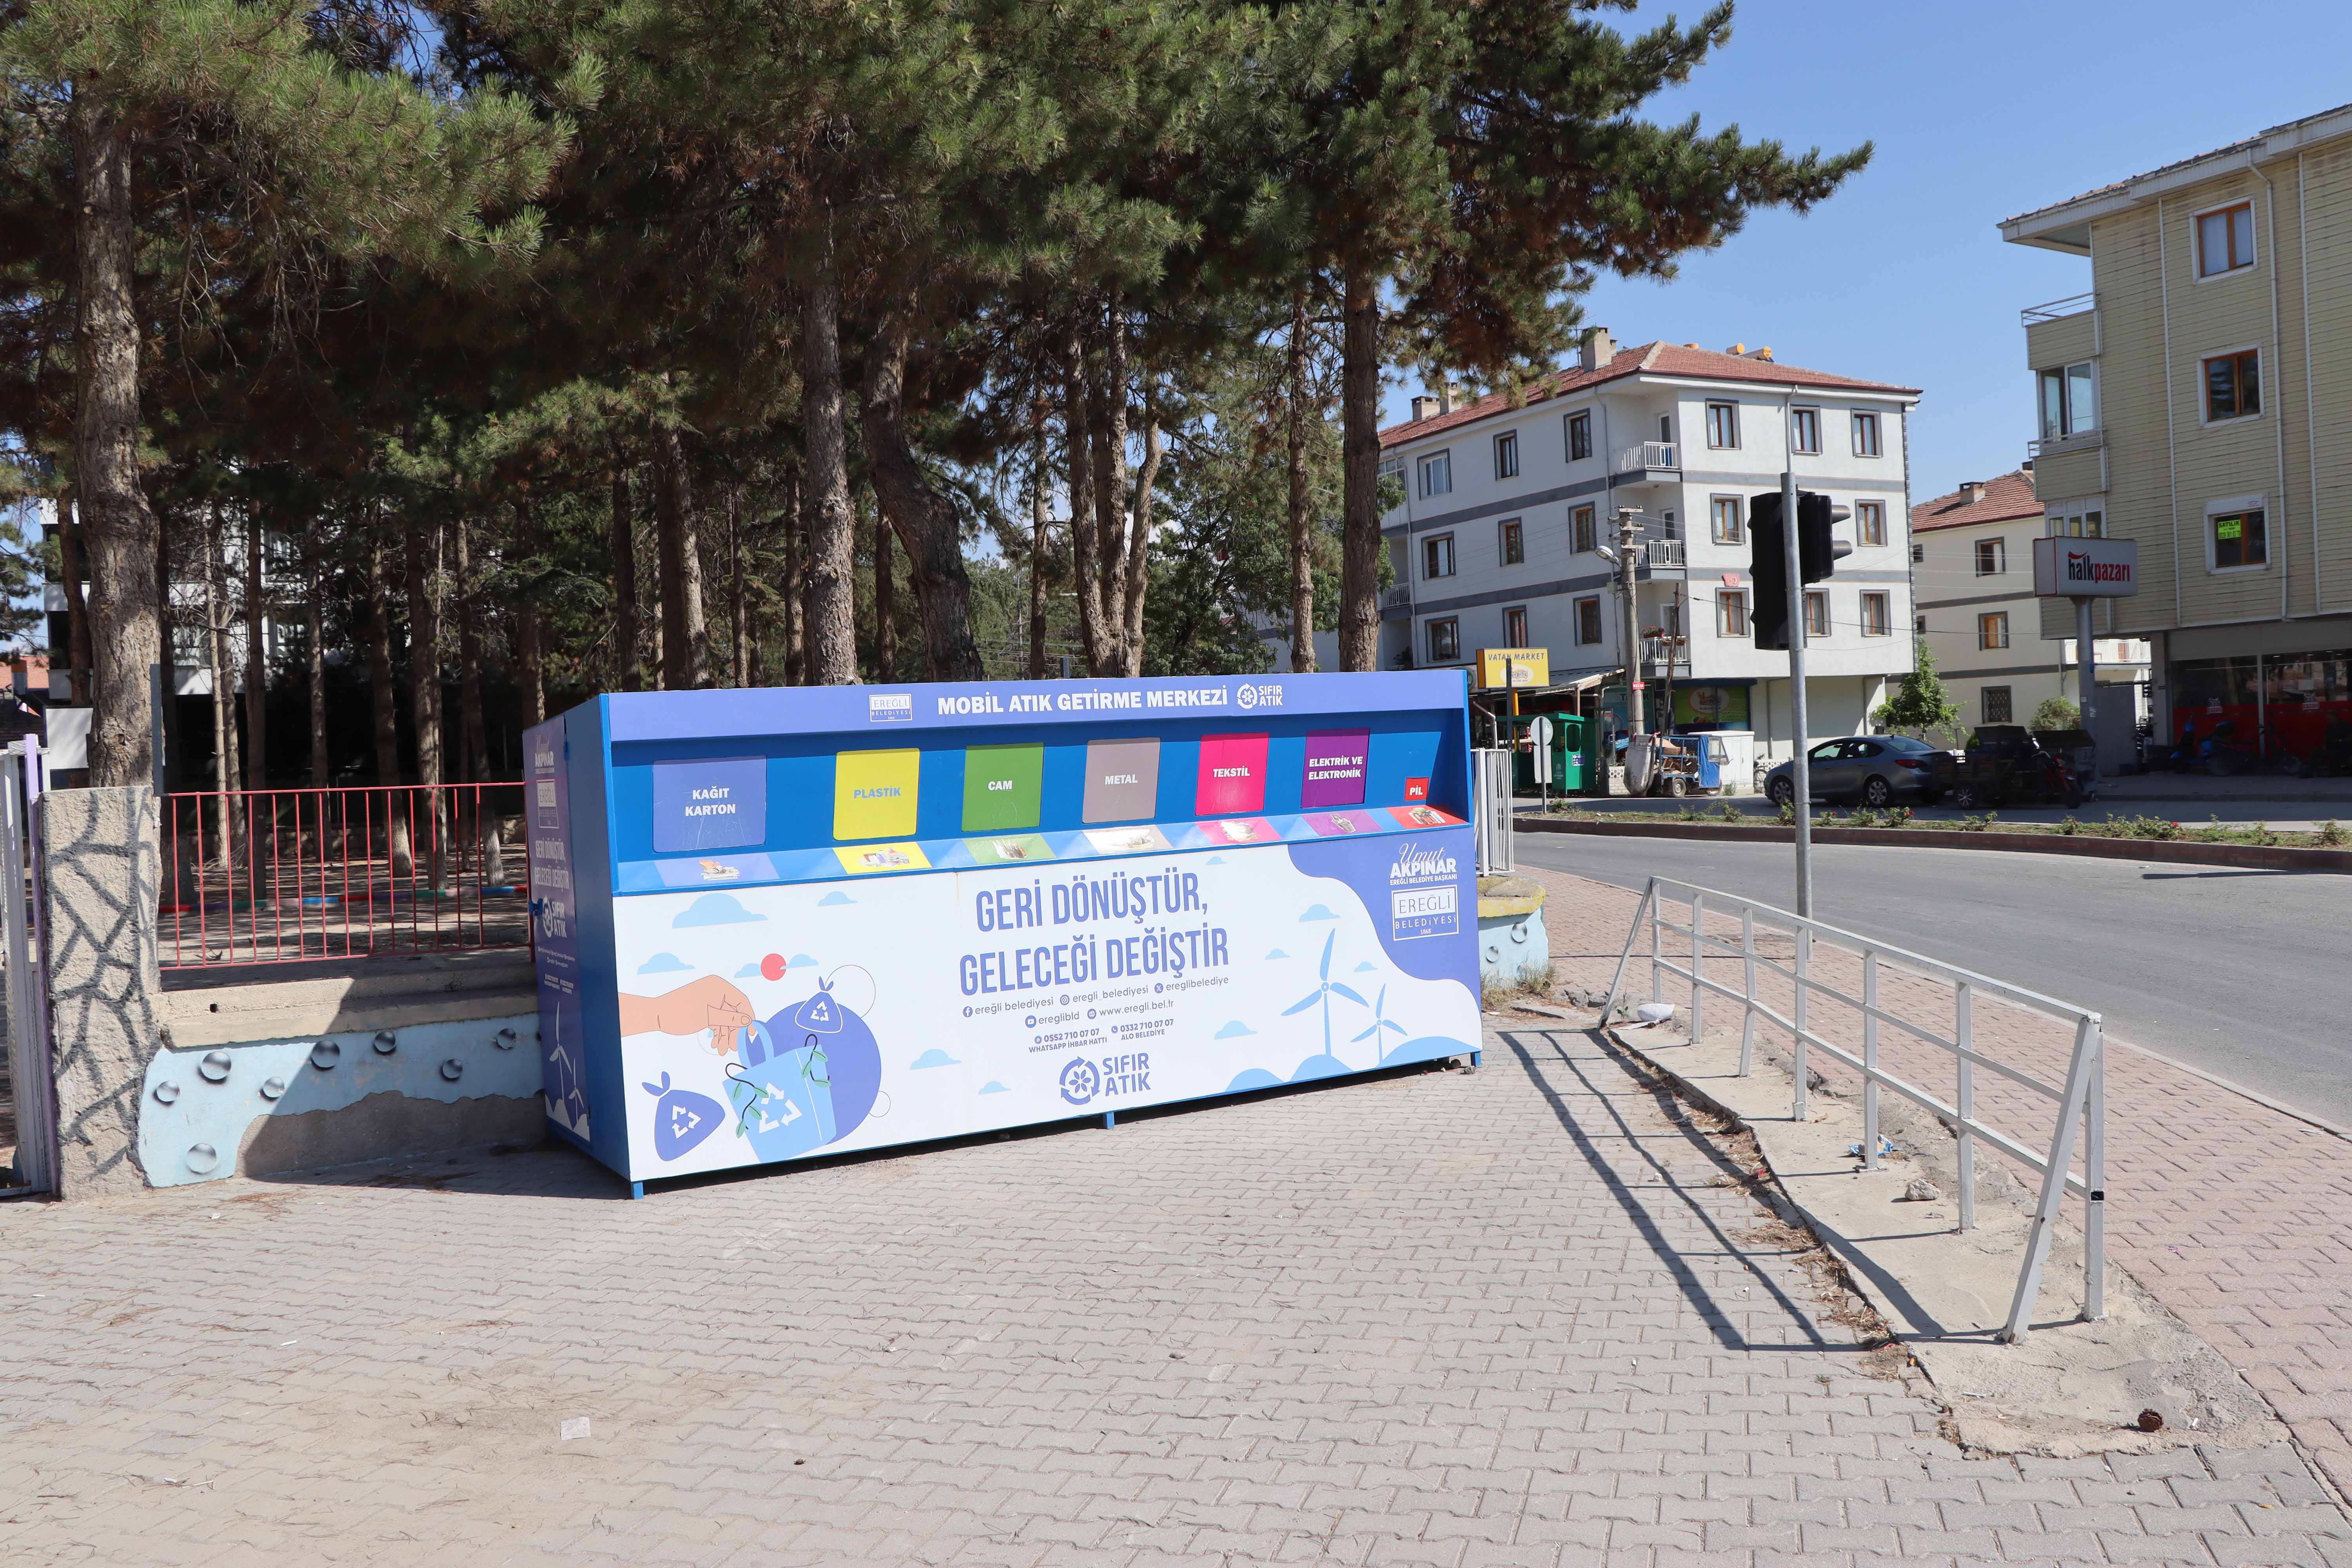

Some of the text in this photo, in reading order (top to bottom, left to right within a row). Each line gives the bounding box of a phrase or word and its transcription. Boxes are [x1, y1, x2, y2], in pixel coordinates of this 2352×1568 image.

[1514, 653, 1544, 661] MARKET
[1259, 685, 1283, 695] SIFIR
[874, 697, 907, 708] EREĞLİ
[938, 684, 1227, 715] MOBİL ATIK GETİRME MERKEZİ
[1259, 695, 1283, 706] ATIK
[1309, 755, 1363, 767] ELEKTRİK VE
[1212, 765, 1250, 778] TEKSTİL
[1308, 767, 1361, 780] ELEKTRONİK
[988, 780, 1013, 791] CAM
[1104, 774, 1138, 785] METAL
[692, 786, 730, 800] KAĞIT
[853, 785, 902, 799] PLASTİK
[1409, 785, 1423, 795] PİL
[685, 804, 736, 817] KARTON
[535, 837, 544, 858] GERİ
[1399, 843, 1446, 864] Umut
[1390, 858, 1457, 878] AKPINAR
[1390, 877, 1408, 886] EREĞLİ
[1409, 875, 1434, 884] BELEDİYE
[976, 867, 1208, 932] GERİ DÖNÜŞTÜR,
[1399, 891, 1450, 913] EREĞLİ
[552, 901, 565, 919] SIFIR
[554, 920, 567, 938] ATIK
[960, 922, 1229, 996] GELECEĞİ DEĞİŞTİR
[1166, 976, 1229, 991] ereglibelediye
[975, 996, 1054, 1014] ereğli belediyesi
[1099, 1000, 1174, 1016] www.eregli.bel.tr
[1038, 1011, 1080, 1024] ereglibld
[1120, 1023, 1138, 1032] 0332
[1135, 1028, 1165, 1038] BELEDİYE
[1044, 1033, 1063, 1042] 0552
[1064, 1031, 1078, 1040] 710
[1029, 1043, 1066, 1053] WHATSAPP
[1068, 1040, 1087, 1048] İHBAR
[1102, 1053, 1150, 1075] SIFIR
[1105, 1072, 1151, 1096] ATIK
